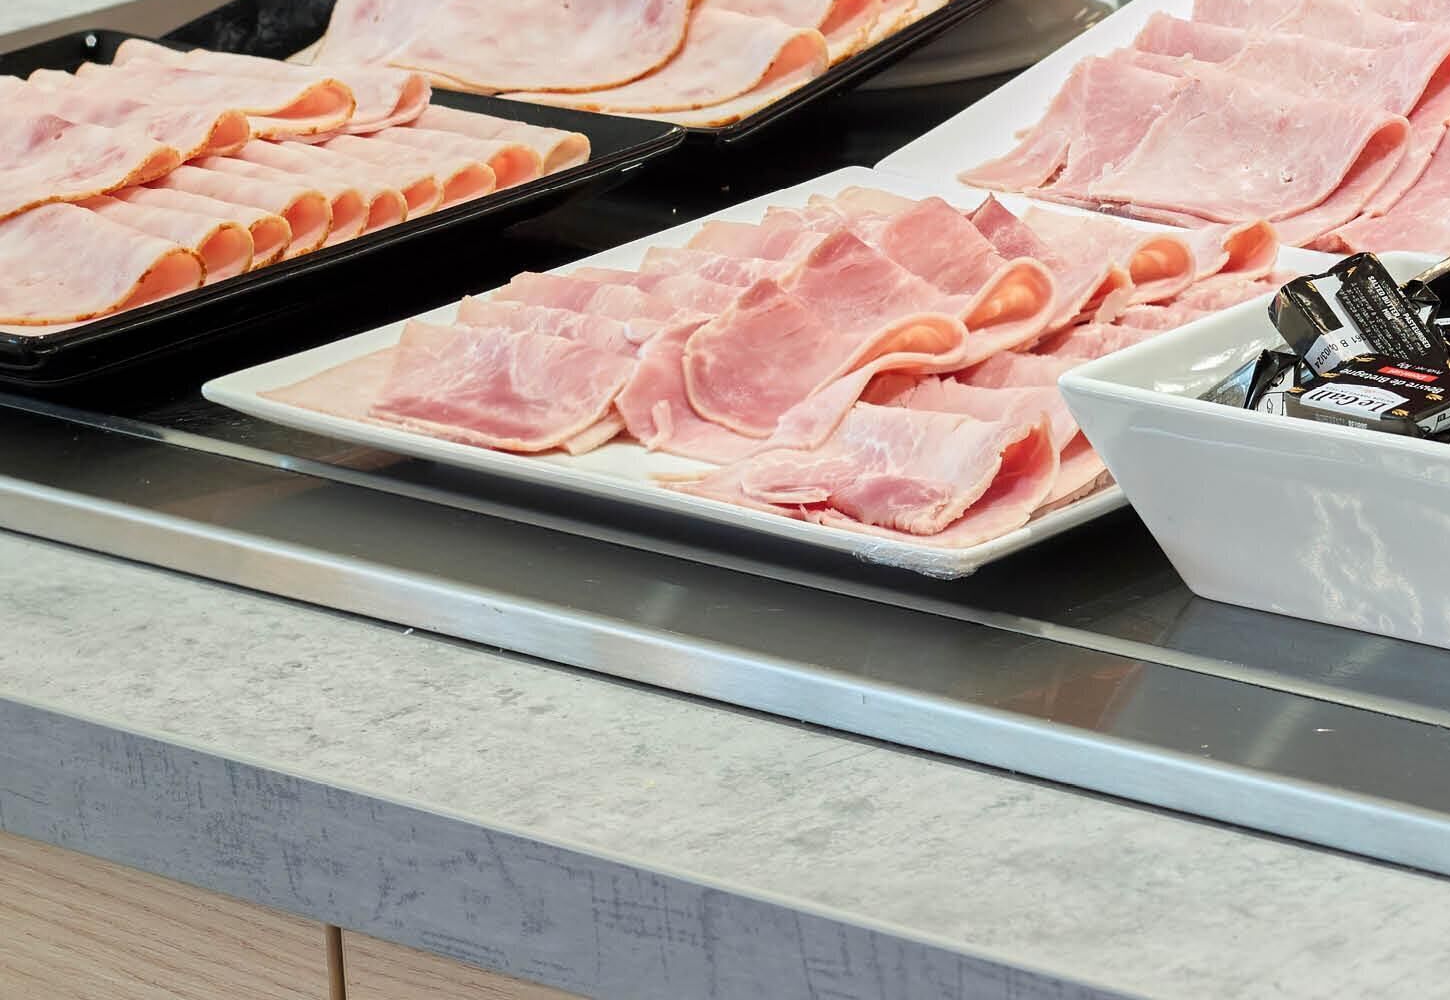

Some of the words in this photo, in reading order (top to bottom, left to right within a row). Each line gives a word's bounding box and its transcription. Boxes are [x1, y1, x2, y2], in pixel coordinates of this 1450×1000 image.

[1368, 274, 1385, 297] SALTED
[1382, 295, 1399, 318] BUTTER
[1403, 311, 1430, 350] PASTEURISED
[1341, 339, 1348, 347] B
[1312, 343, 1339, 367] 0/03/24
[1340, 367, 1390, 382] Bretagne
[1390, 379, 1405, 387] de
[1407, 382, 1445, 394] Beurre
[1309, 388, 1358, 408] Gall
[1358, 399, 1386, 413] Le
